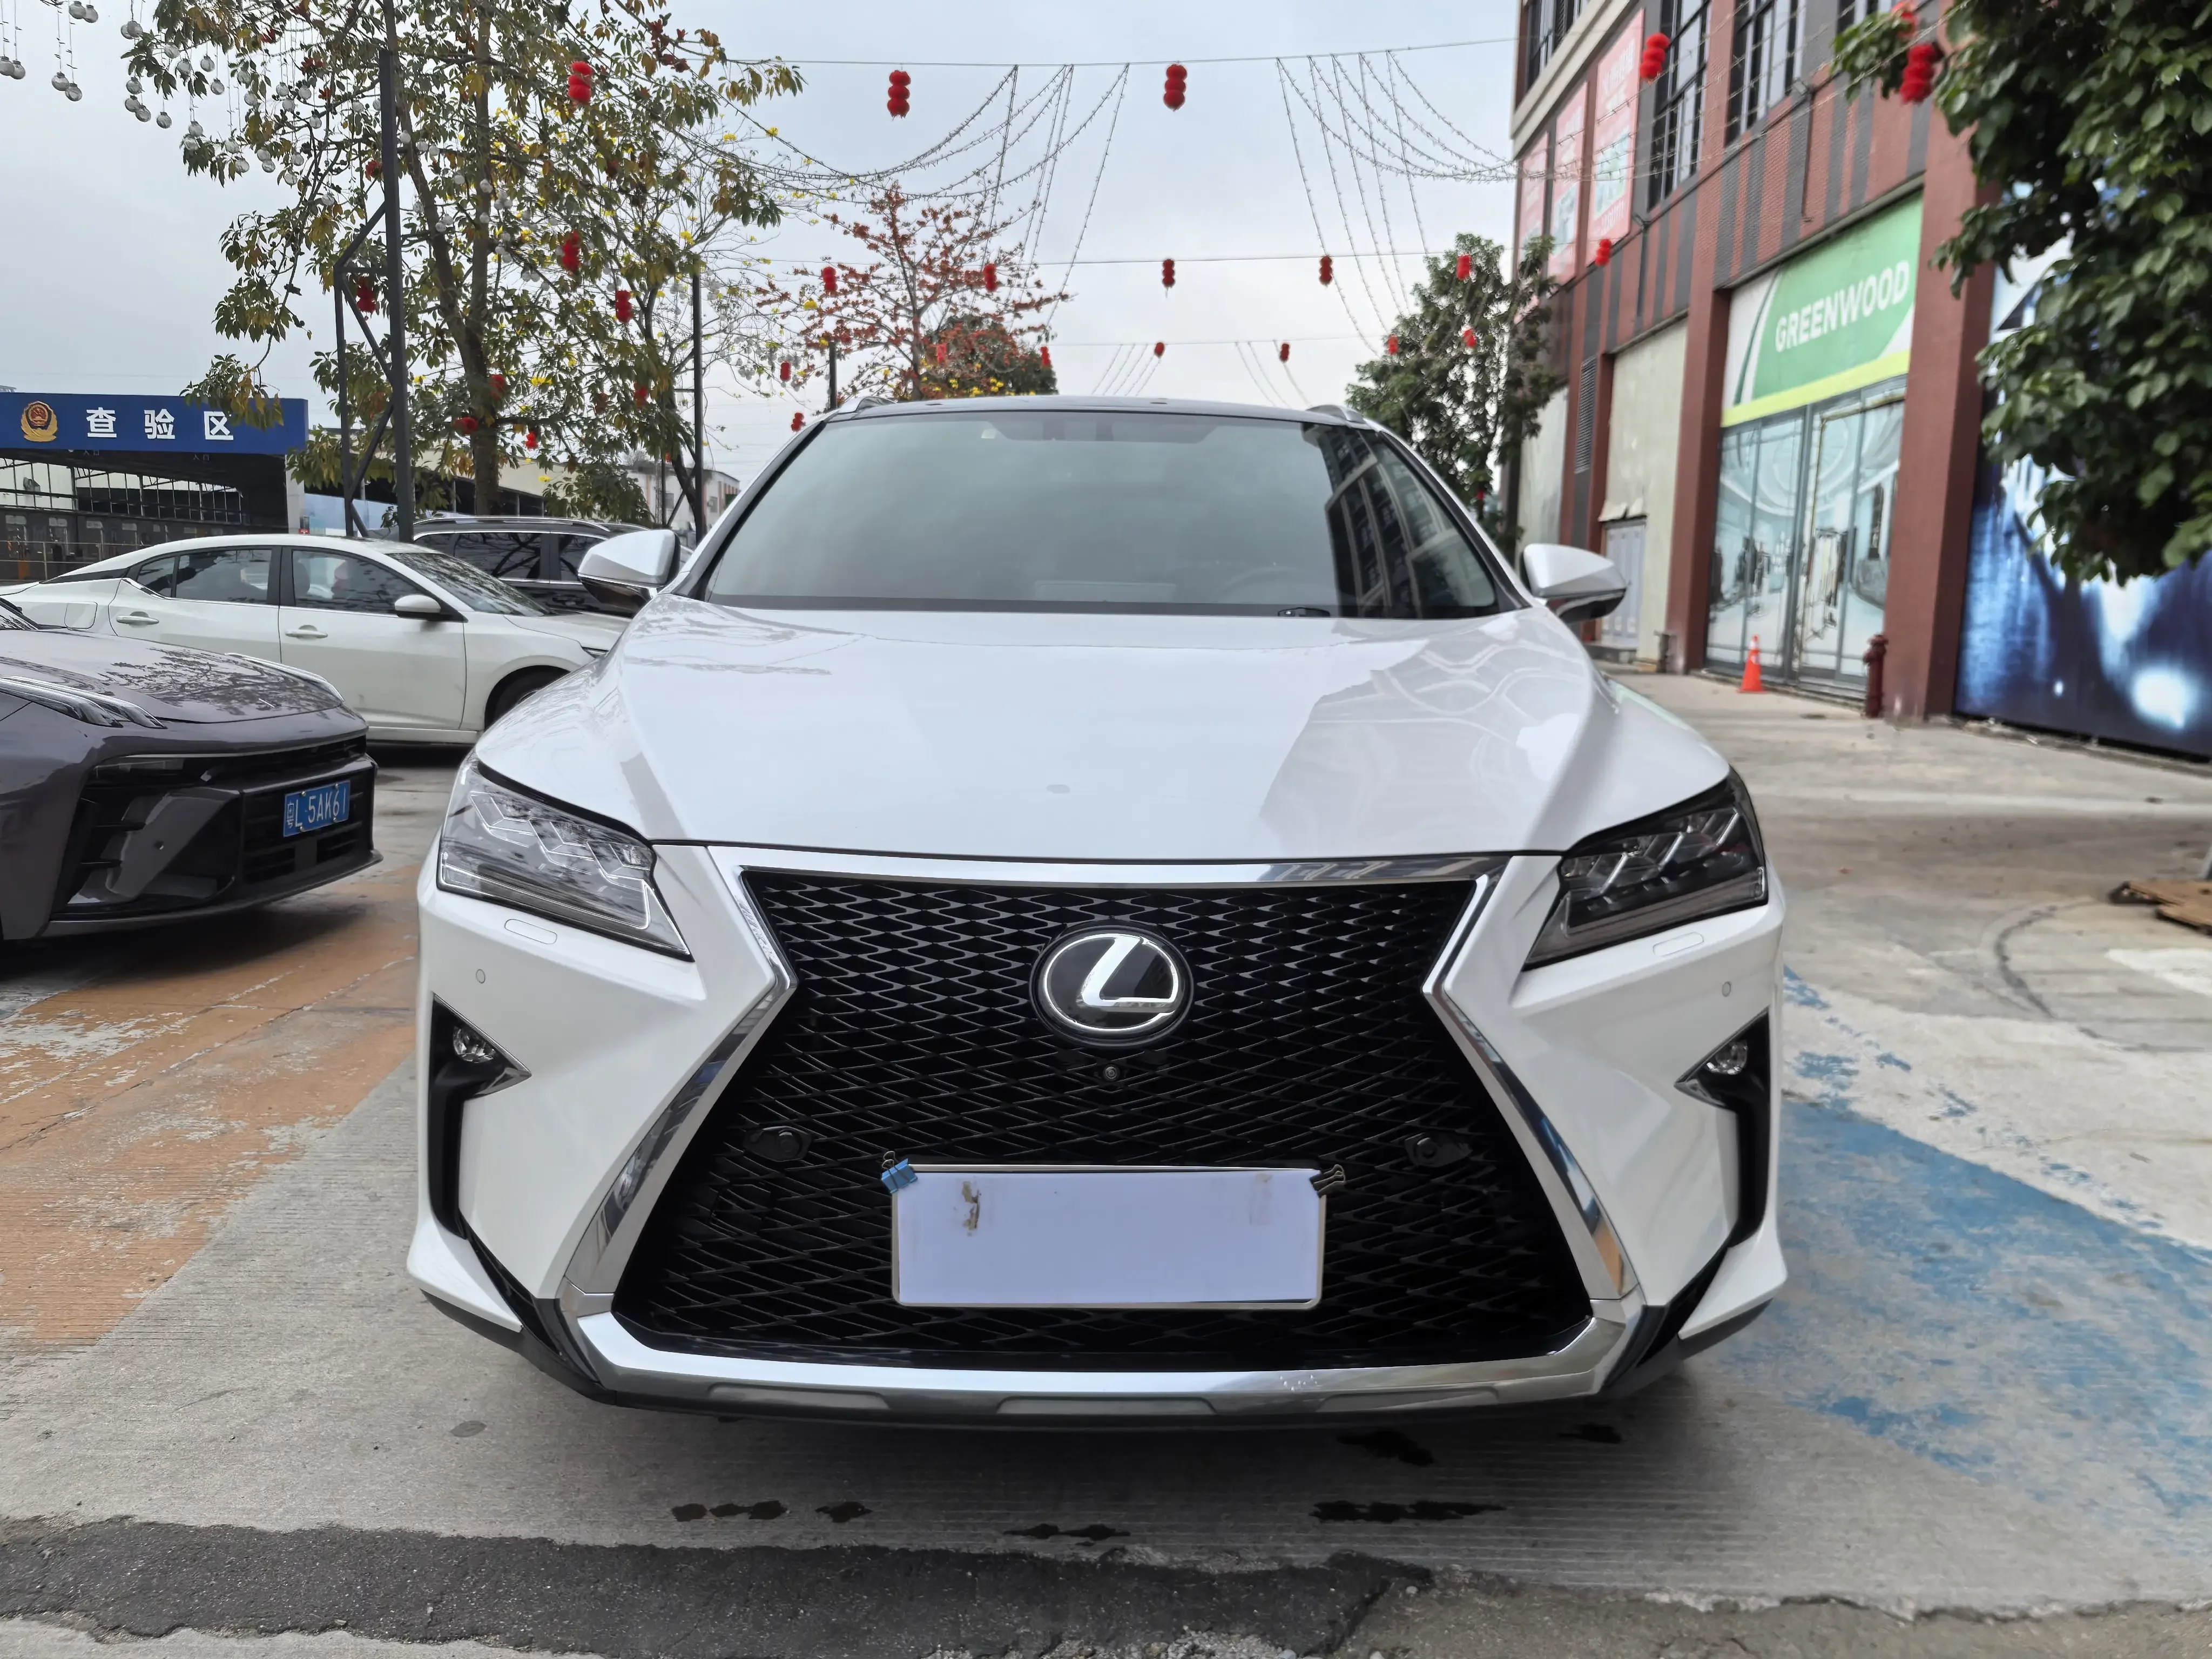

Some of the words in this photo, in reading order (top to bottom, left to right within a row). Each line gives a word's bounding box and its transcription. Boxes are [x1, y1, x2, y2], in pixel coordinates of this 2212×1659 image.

[1775, 260, 1910, 352] GREENWOOD
[86, 407, 234, 441] 查验区
